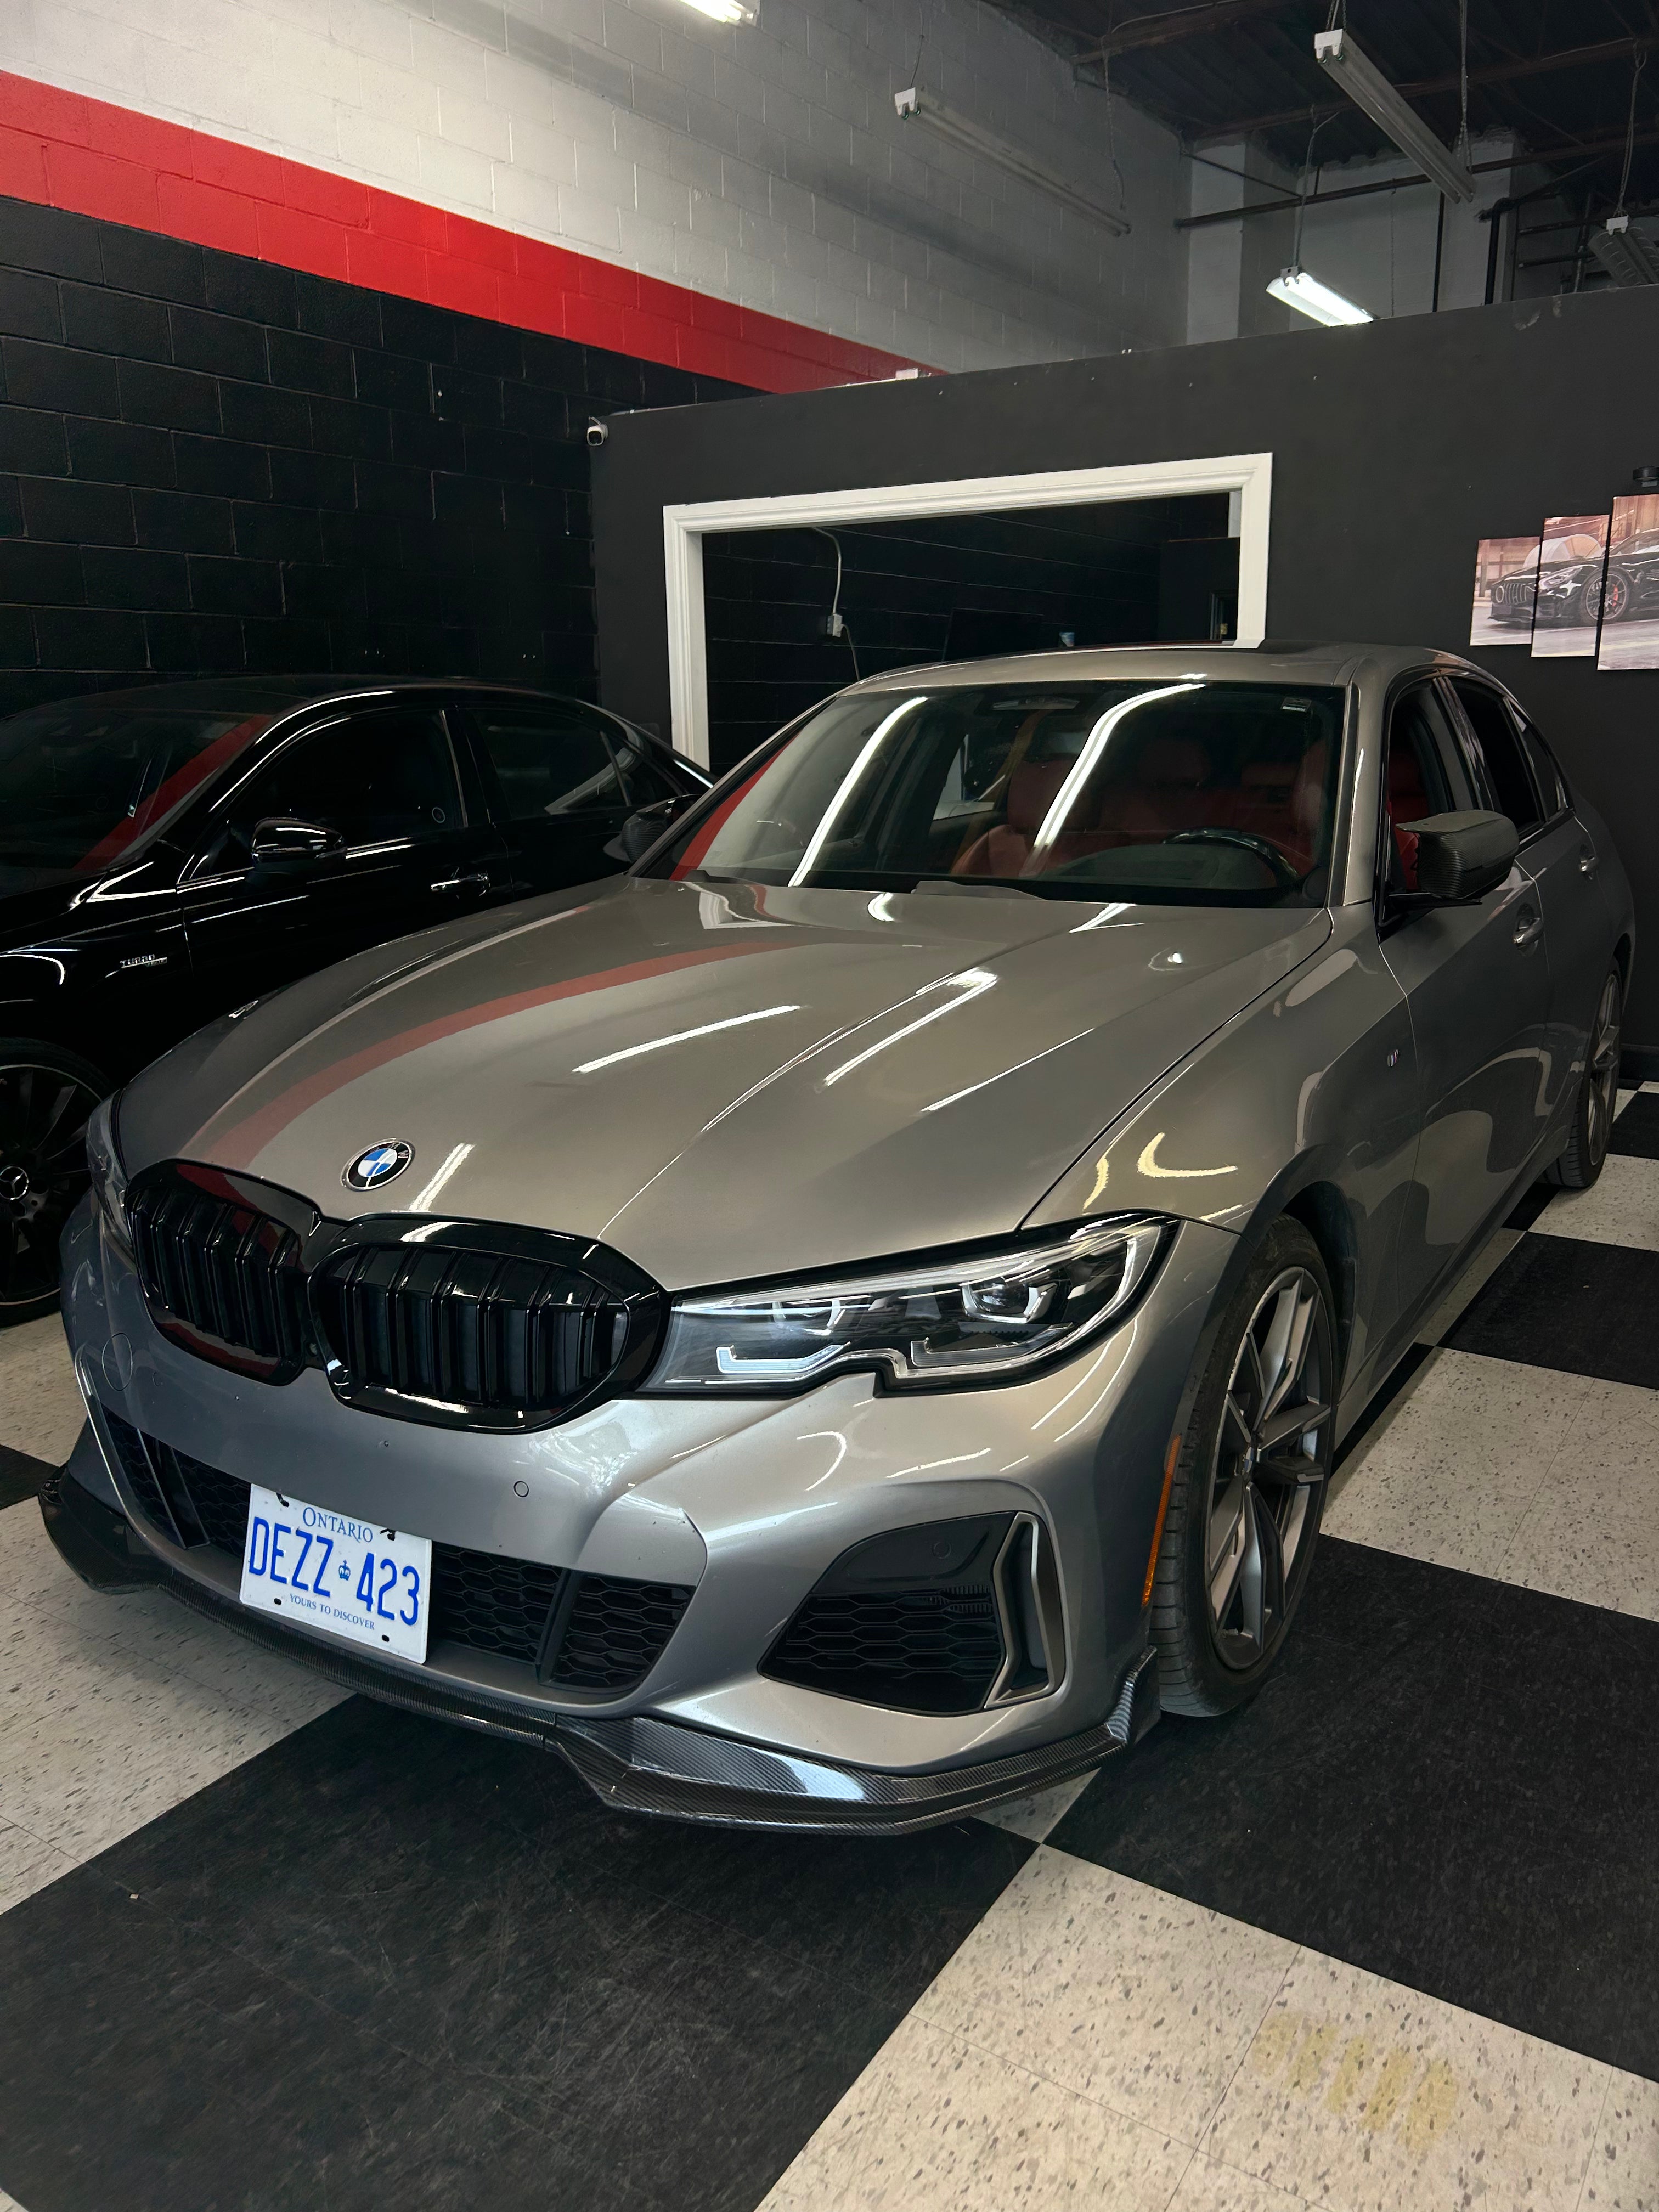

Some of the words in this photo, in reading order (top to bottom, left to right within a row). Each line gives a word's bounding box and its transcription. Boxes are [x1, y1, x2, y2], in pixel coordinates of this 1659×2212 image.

[302, 1506, 373, 1543] ONTARIO
[249, 1516, 334, 1598] DEZZ
[356, 1552, 420, 1626] 423
[290, 1593, 317, 1610] YOURS
[319, 1603, 331, 1615] TO
[334, 1610, 375, 1630] DISCOVER
